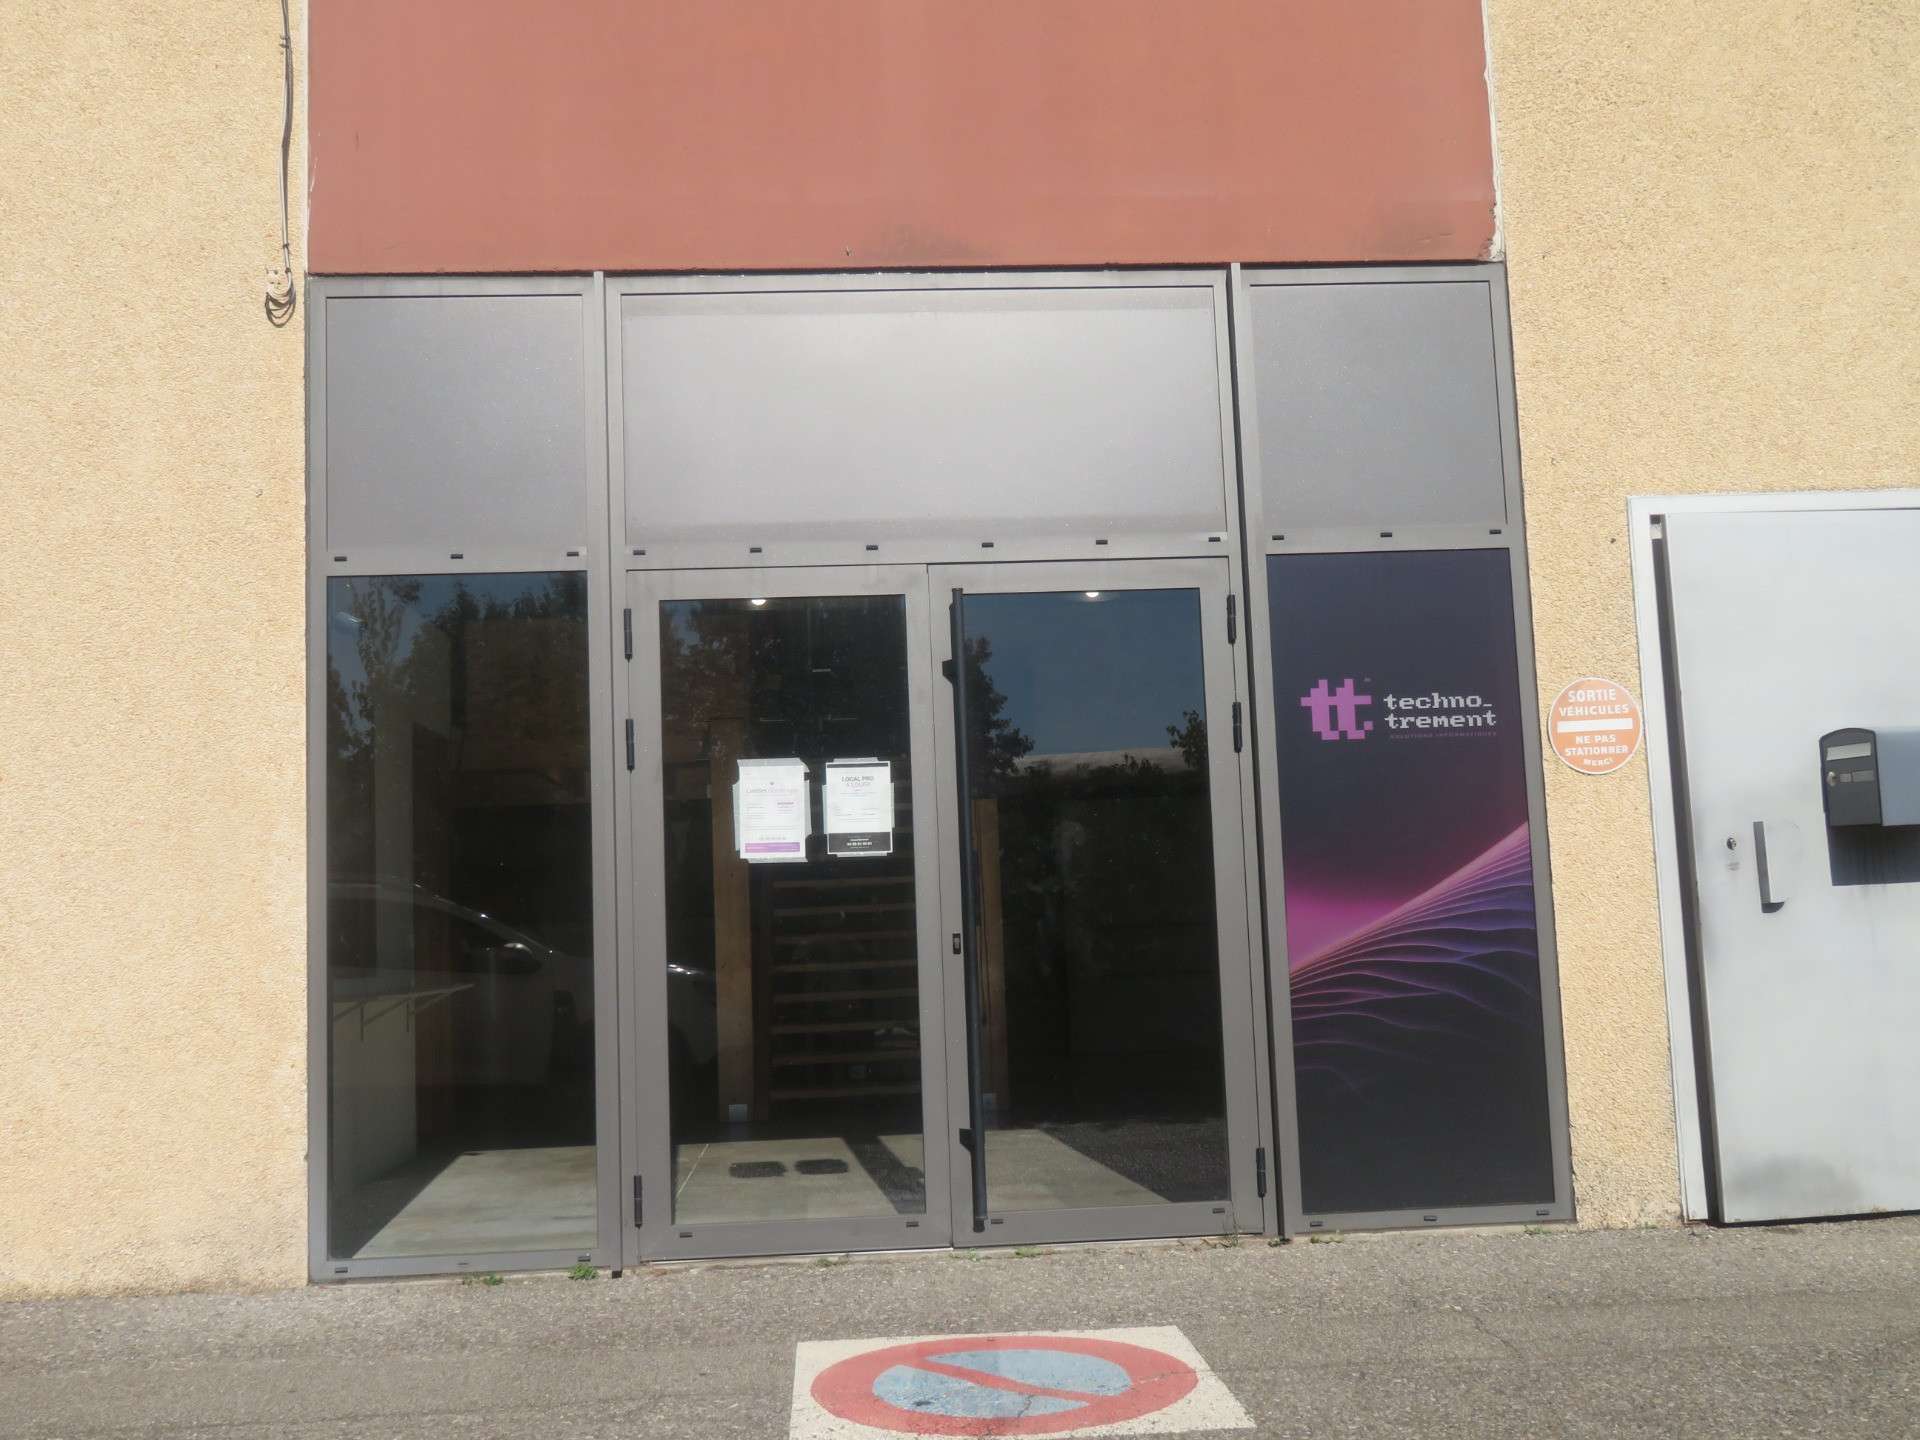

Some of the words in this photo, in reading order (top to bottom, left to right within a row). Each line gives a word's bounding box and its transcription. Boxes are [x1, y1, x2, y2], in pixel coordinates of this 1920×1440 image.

[1568, 688, 1616, 702] SORTIE
[1384, 709, 1497, 729] trement
[1576, 735, 1591, 745] NE
[1594, 734, 1616, 743] PAS
[1565, 745, 1628, 756] STATIONNER
